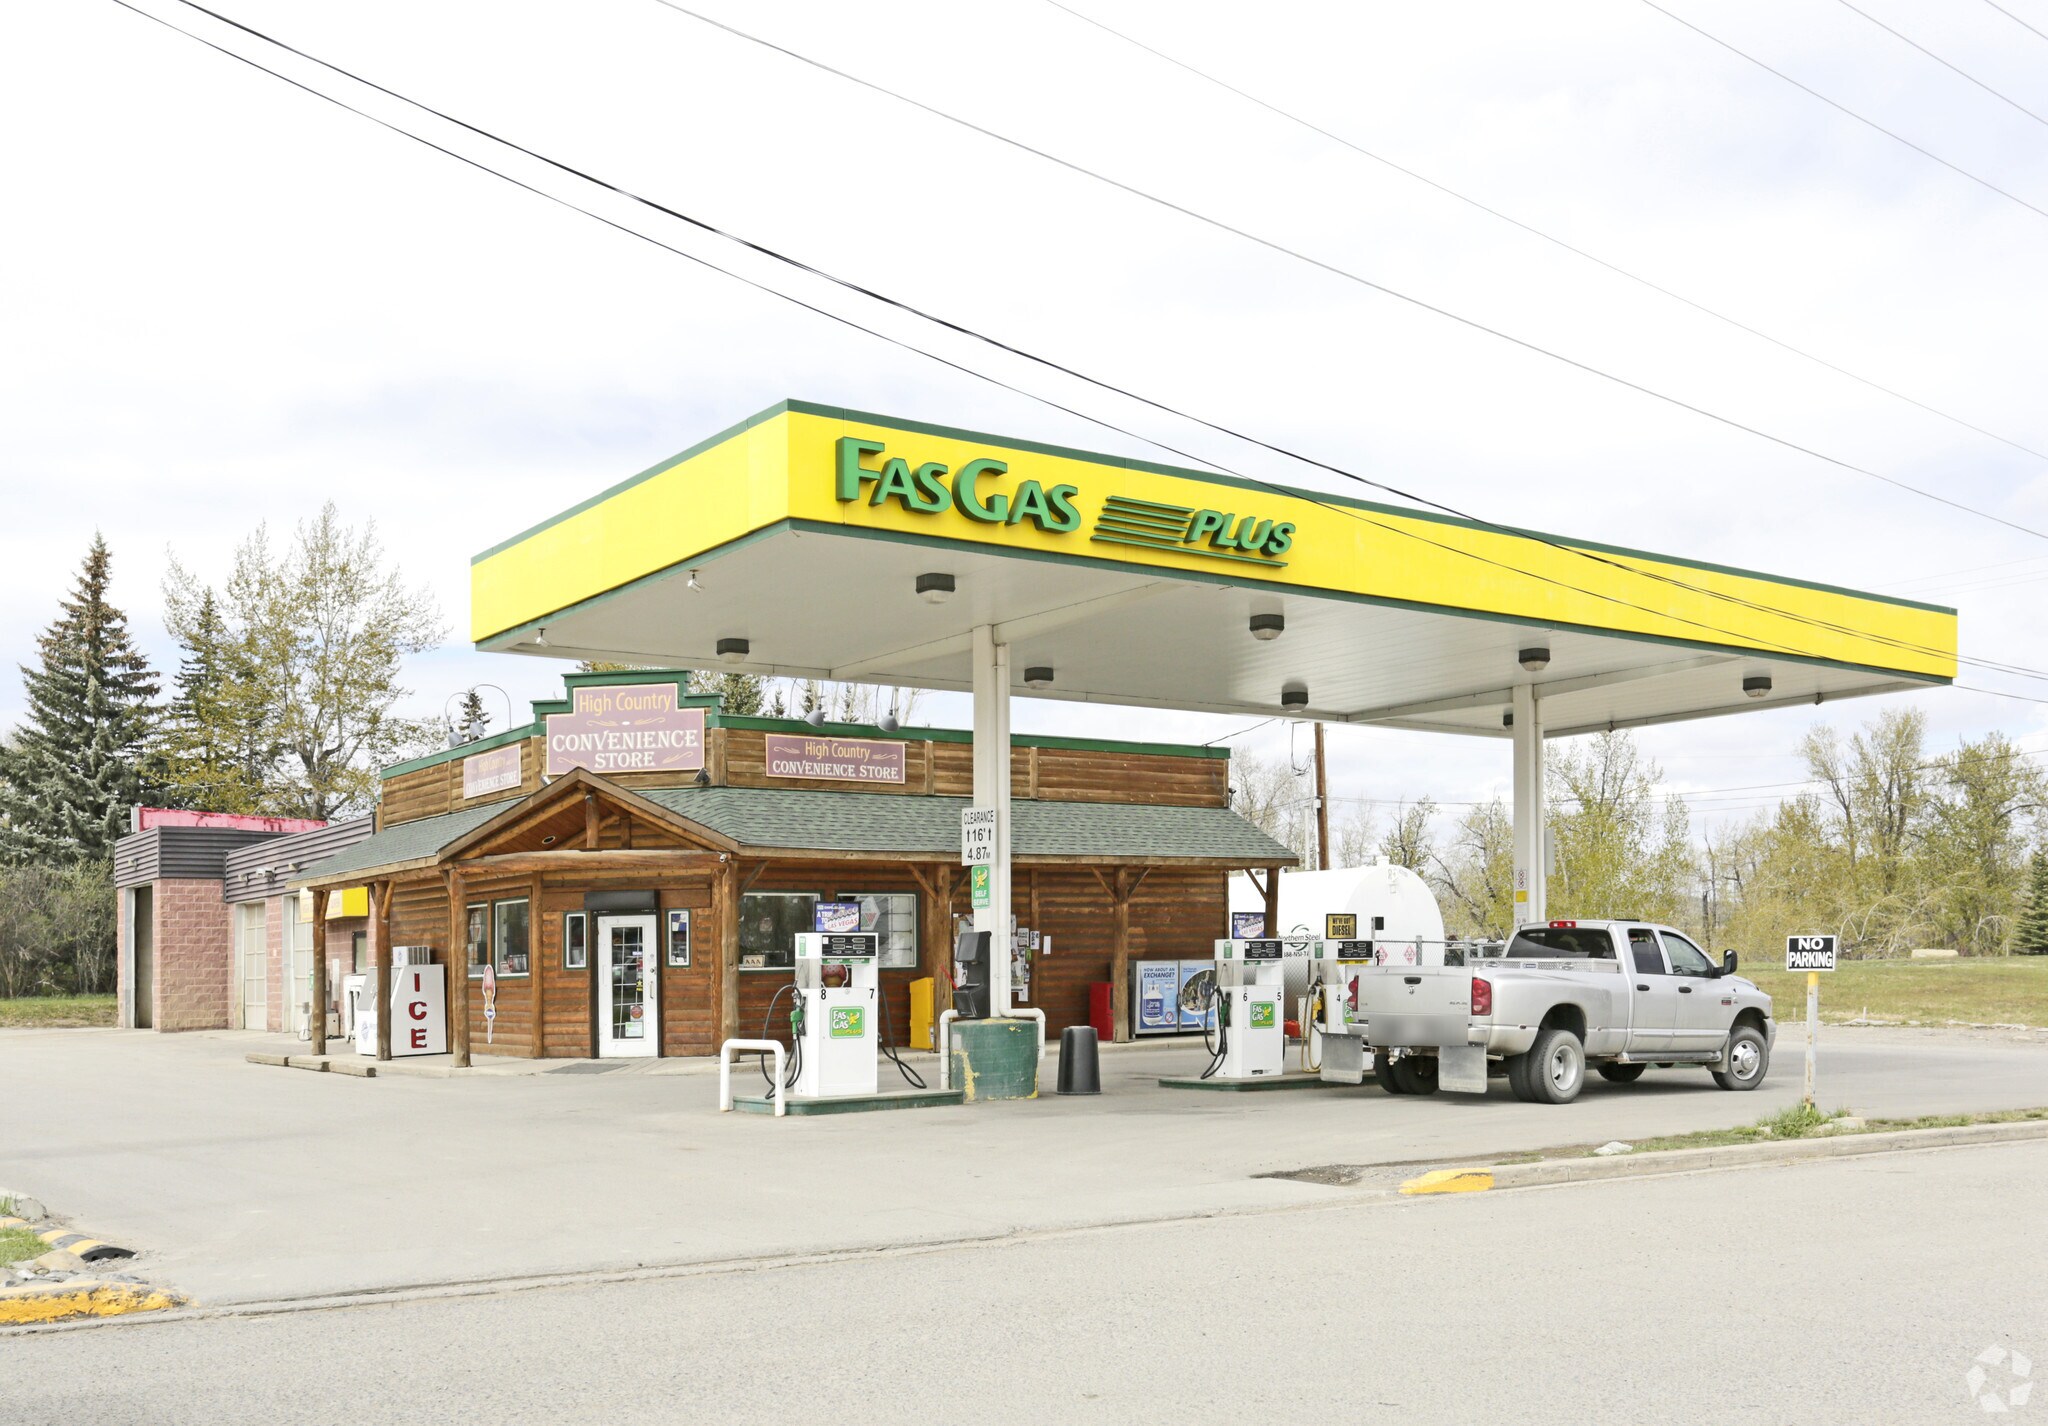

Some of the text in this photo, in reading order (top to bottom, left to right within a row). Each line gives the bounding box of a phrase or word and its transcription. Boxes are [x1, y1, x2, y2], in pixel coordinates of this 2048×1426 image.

[1184, 508, 1296, 556] PLUS
[579, 692, 672, 716] High Country
[552, 730, 699, 752] CONVENIENCE
[805, 742, 871, 762] High Country
[594, 751, 656, 769] STORE
[772, 760, 899, 780] CONVENIENCE STORE
[964, 810, 994, 824] CLEARANCE
[972, 827, 986, 842] 16'
[975, 890, 987, 898] SELF
[973, 898, 989, 906] SERVE
[838, 918, 858, 927] VEGAS
[1332, 924, 1351, 936] DIESEL
[1305, 933, 1321, 941] Steel
[1798, 938, 1824, 950] NO
[1789, 951, 1832, 967] PARKING
[820, 988, 827, 1000] 8
[869, 988, 875, 1000] 7
[1243, 992, 1248, 1001] 6
[1277, 992, 1282, 1000] 5
[1336, 994, 1341, 1002] 4
[408, 972, 428, 1049] ICE
[1252, 1004, 1262, 1012] FAS
[833, 1010, 847, 1019] FAS
[833, 1019, 849, 1029] GAS
